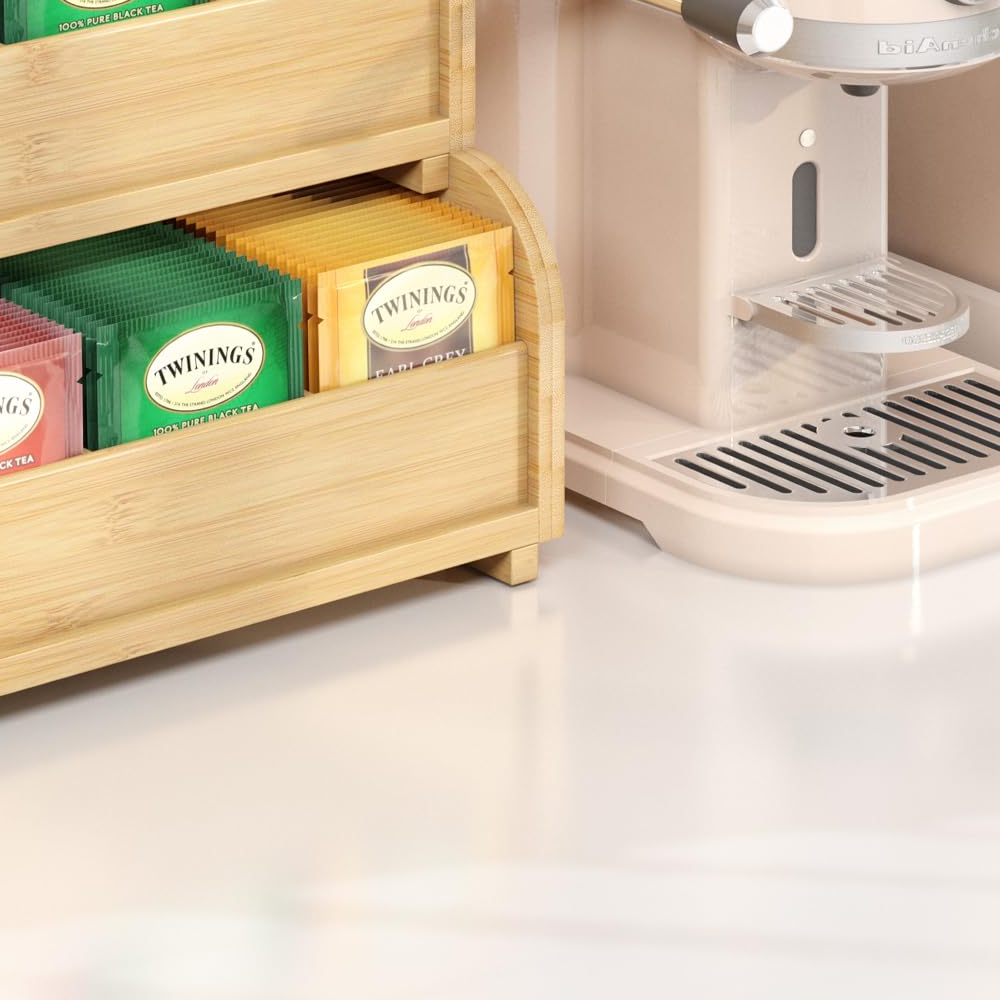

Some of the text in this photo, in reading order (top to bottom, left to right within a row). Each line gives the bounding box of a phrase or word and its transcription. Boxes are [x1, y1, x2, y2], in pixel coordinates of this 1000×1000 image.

[58, 4, 164, 32] 100% PURE BLACK TEA
[371, 286, 468, 324] TWININGS
[154, 346, 255, 386] TWININGS
[153, 404, 260, 436] 100% PURE BLACK TEA
[16, 454, 34, 464] TEA
